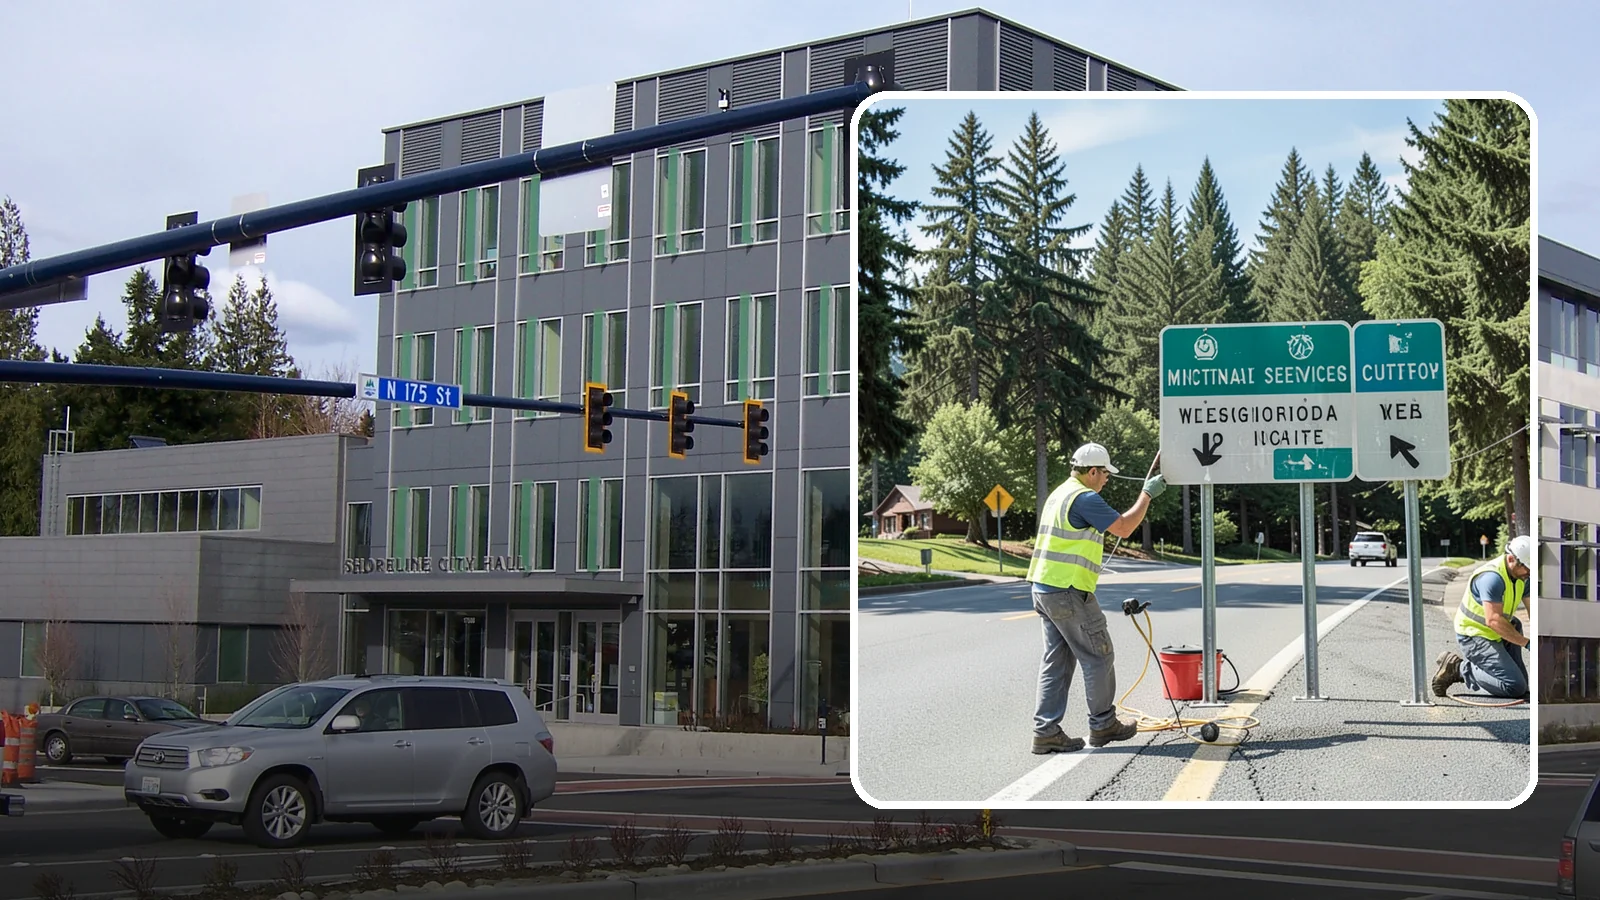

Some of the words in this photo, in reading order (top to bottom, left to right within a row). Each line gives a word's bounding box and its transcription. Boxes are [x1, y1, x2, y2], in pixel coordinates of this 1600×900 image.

[387, 380, 396, 400] N
[404, 382, 427, 403] 175
[435, 386, 451, 406] St
[344, 557, 431, 574] SHORELINE
[438, 556, 475, 572] CITY
[483, 555, 525, 571] HALL
